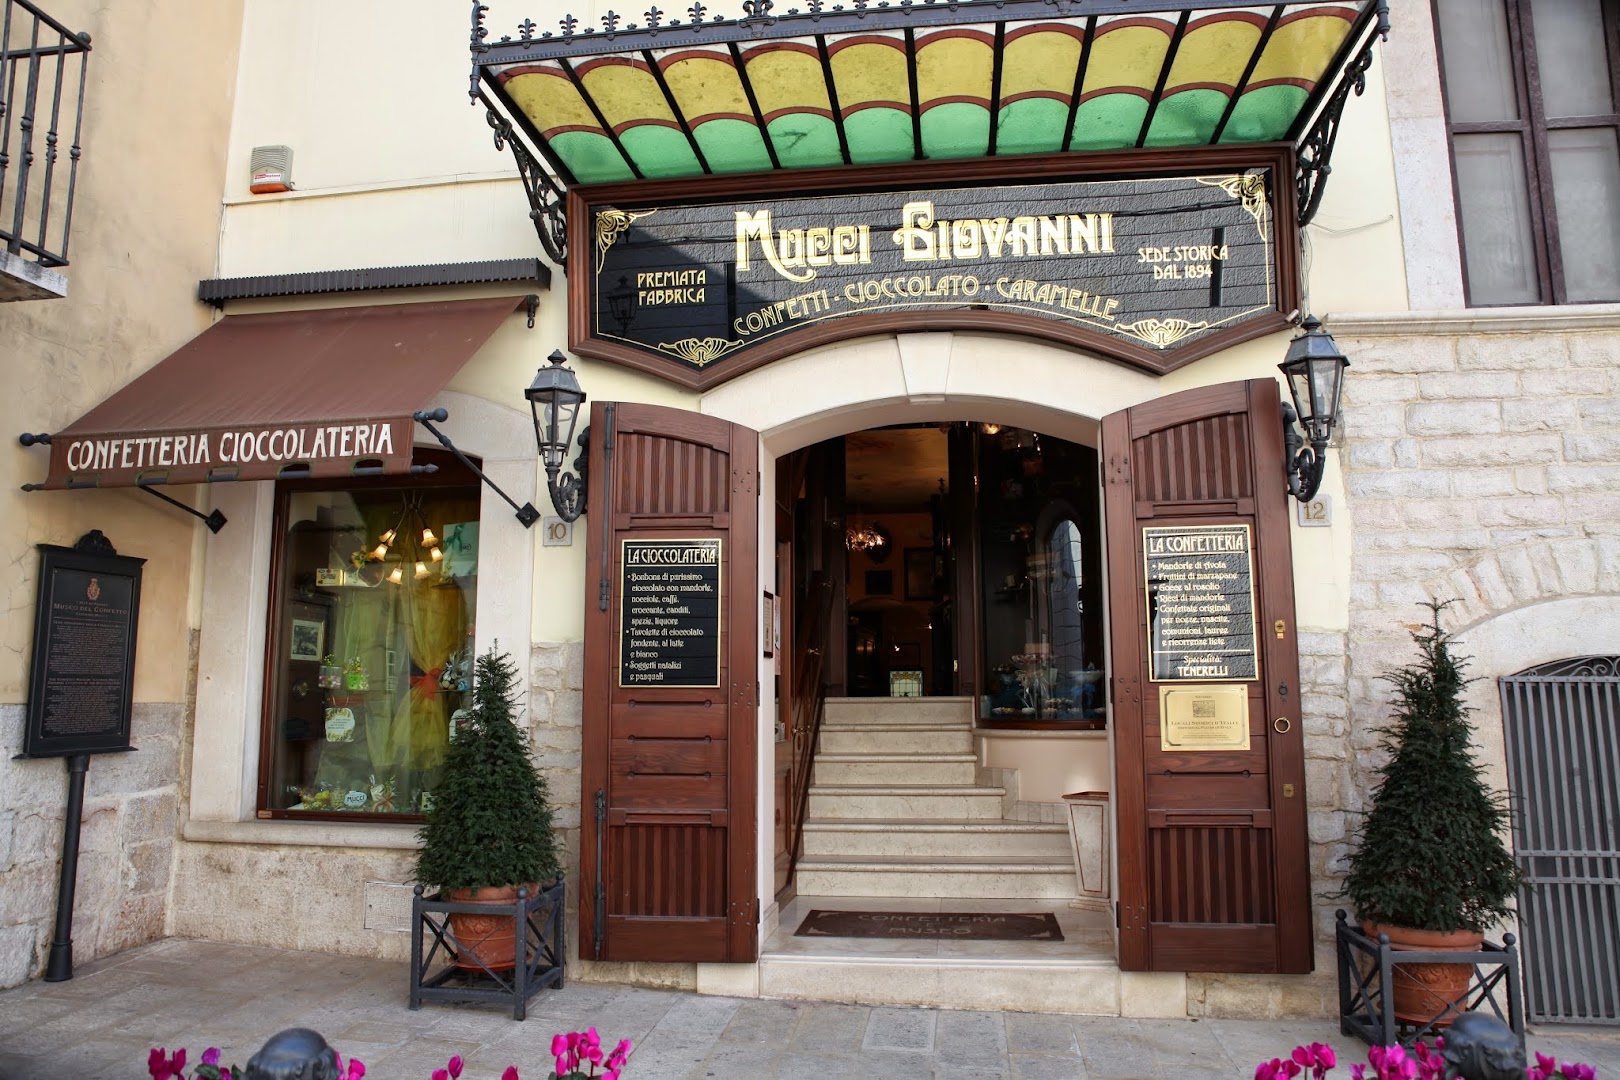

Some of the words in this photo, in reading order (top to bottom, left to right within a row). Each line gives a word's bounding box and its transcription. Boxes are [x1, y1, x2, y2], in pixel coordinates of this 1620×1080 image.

[1138, 247, 1172, 263] SEDE
[1173, 245, 1229, 261] STORICA
[1153, 264, 1183, 280] DAL
[1184, 263, 1213, 279] 1894
[637, 269, 706, 288] PREMIATA
[638, 287, 706, 306] FABBRICA
[733, 289, 830, 336] CONFETTI
[845, 275, 979, 302] CIOCCOLATO
[996, 277, 1119, 321] CARAMELLE
[66, 433, 211, 471] CONFETTERIA
[219, 423, 394, 463] CIOCCOLATERIA
[1304, 501, 1326, 520] 12
[548, 522, 566, 540] 10
[1150, 537, 1164, 552] LA
[1166, 534, 1244, 552] CONFETTERIA
[628, 549, 640, 564] LA
[641, 548, 716, 564] CIOCCOLATERIA
[1158, 562, 1193, 570] Mandorle
[631, 572, 661, 582] Bonbons
[1193, 582, 1220, 590] rosolio
[1199, 604, 1231, 613] originali
[655, 618, 678, 626] liquore
[630, 628, 660, 636] Tavolette
[670, 639, 684, 647] latte
[629, 661, 656, 670] Soggetti
[1177, 666, 1228, 676] TENERELLI
[636, 672, 664, 682] pasquali
[858, 914, 1006, 923] CONFETTERIA
